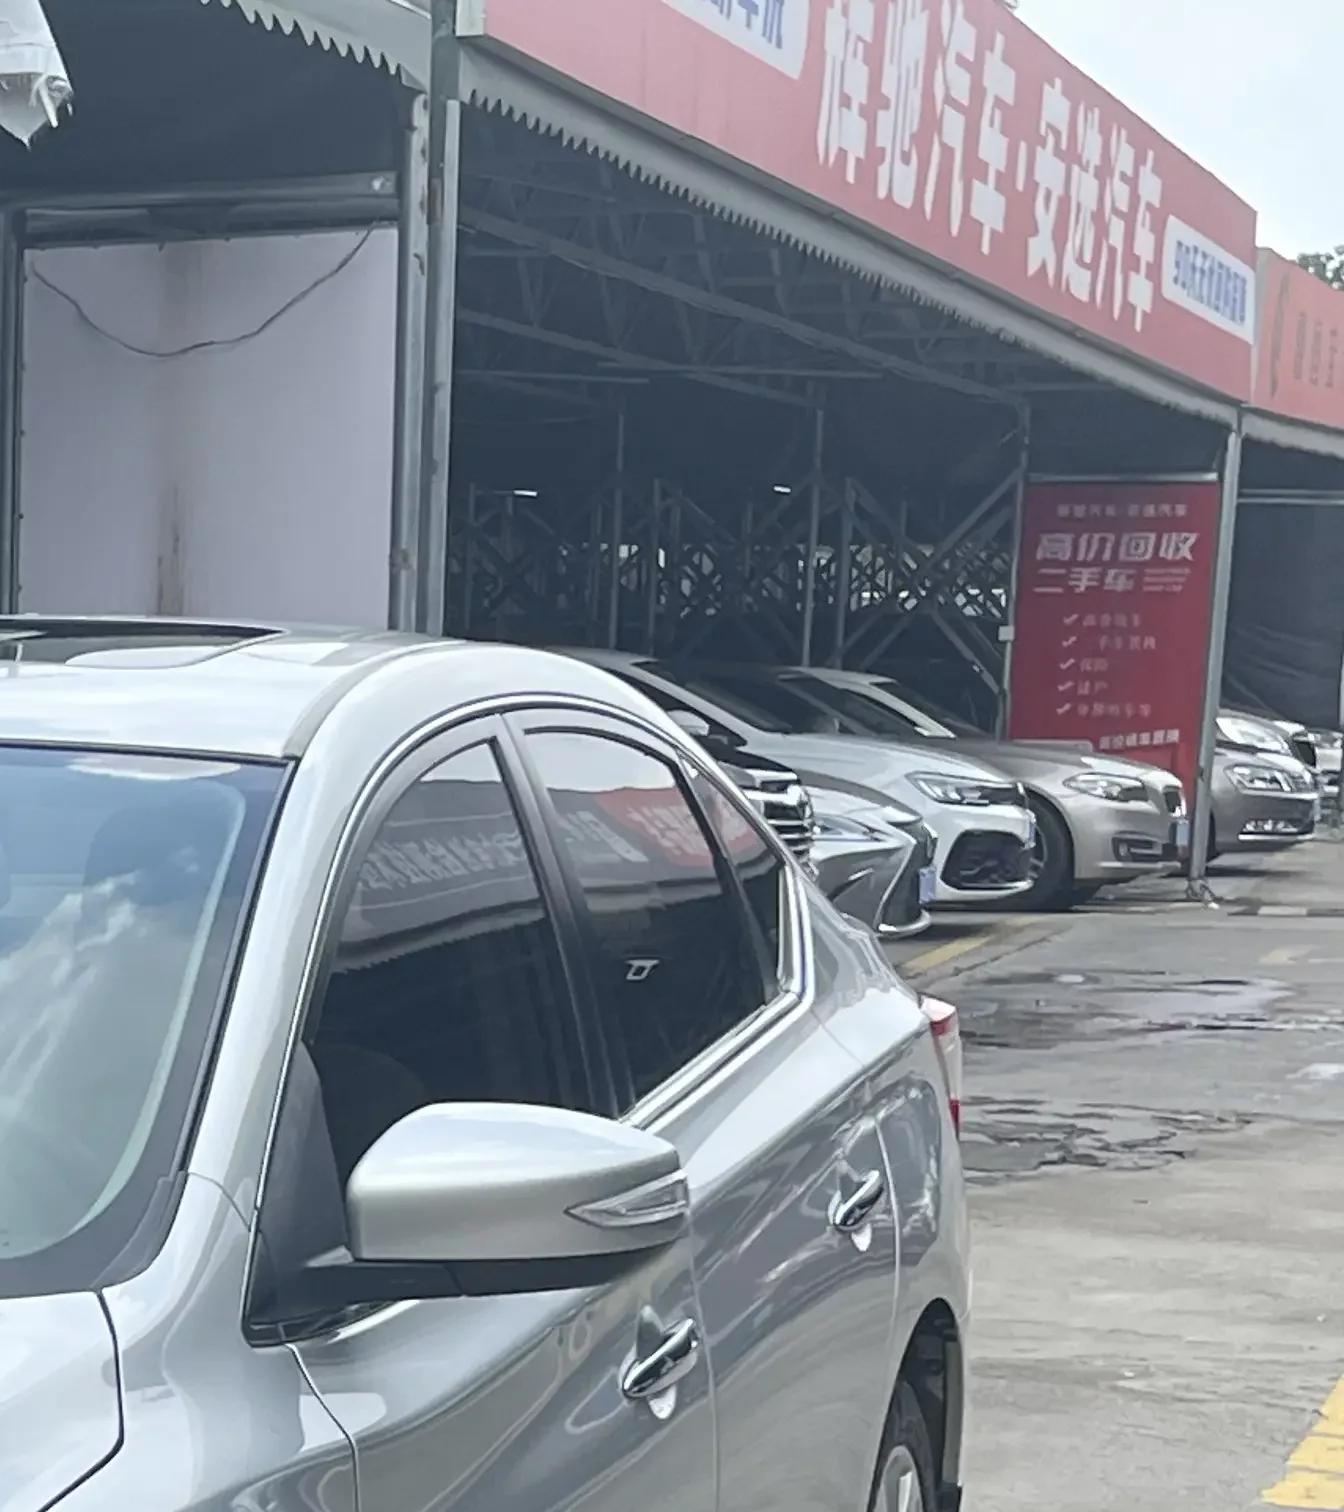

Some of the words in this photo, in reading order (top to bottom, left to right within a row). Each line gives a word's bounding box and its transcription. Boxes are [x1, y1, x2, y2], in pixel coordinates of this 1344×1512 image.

[1035, 531, 1200, 561] 高价回收
[1032, 567, 1137, 593] 二手车
